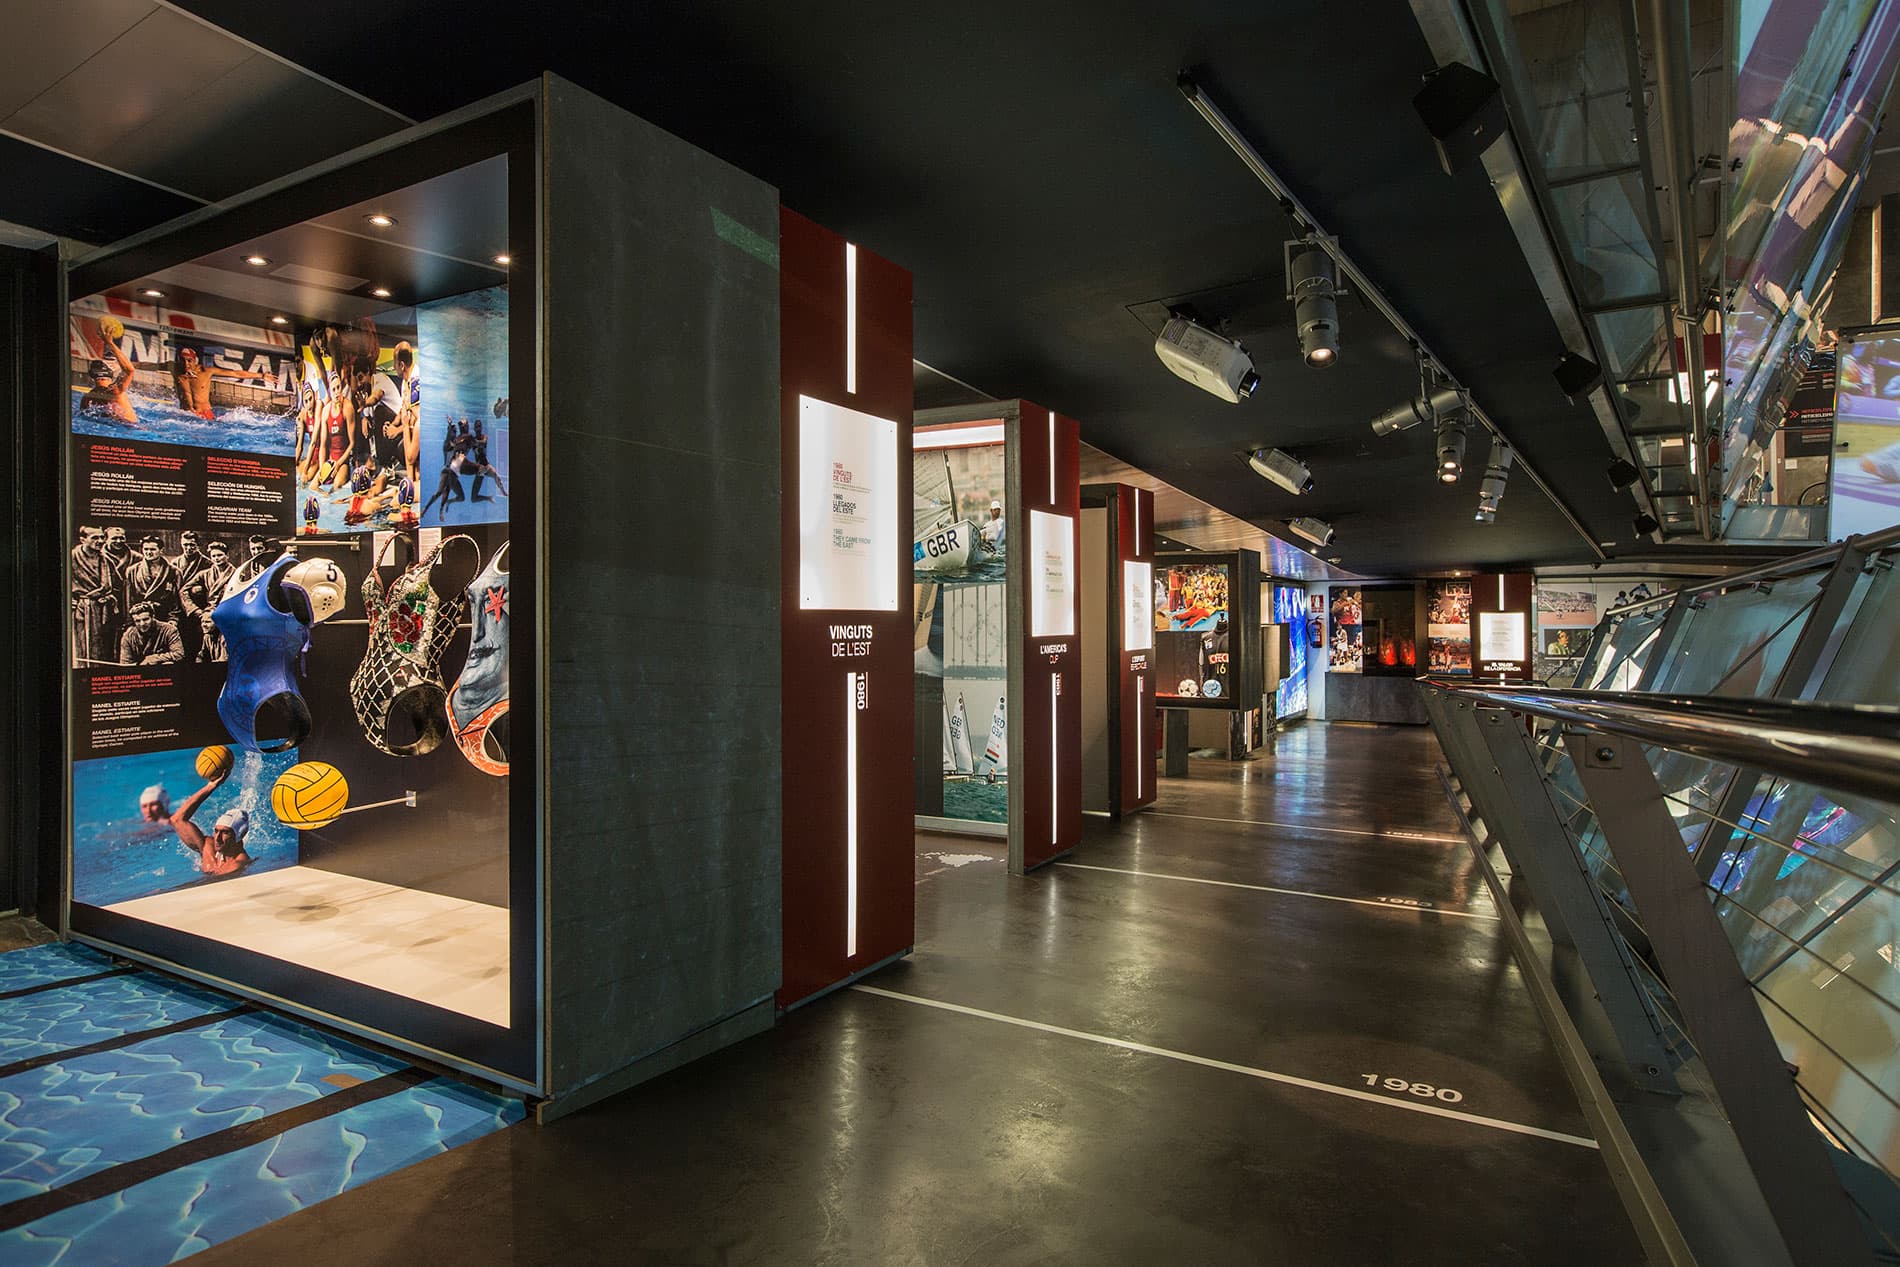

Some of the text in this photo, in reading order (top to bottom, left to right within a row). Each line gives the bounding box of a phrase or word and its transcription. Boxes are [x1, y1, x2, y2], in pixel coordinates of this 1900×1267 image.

[927, 530, 960, 558] GBR
[327, 562, 337, 582] 5
[830, 625, 873, 640] VINGUTS
[832, 642, 871, 657] DE L'EST
[857, 673, 865, 710] 1980
[1361, 1073, 1463, 1104] 1980
